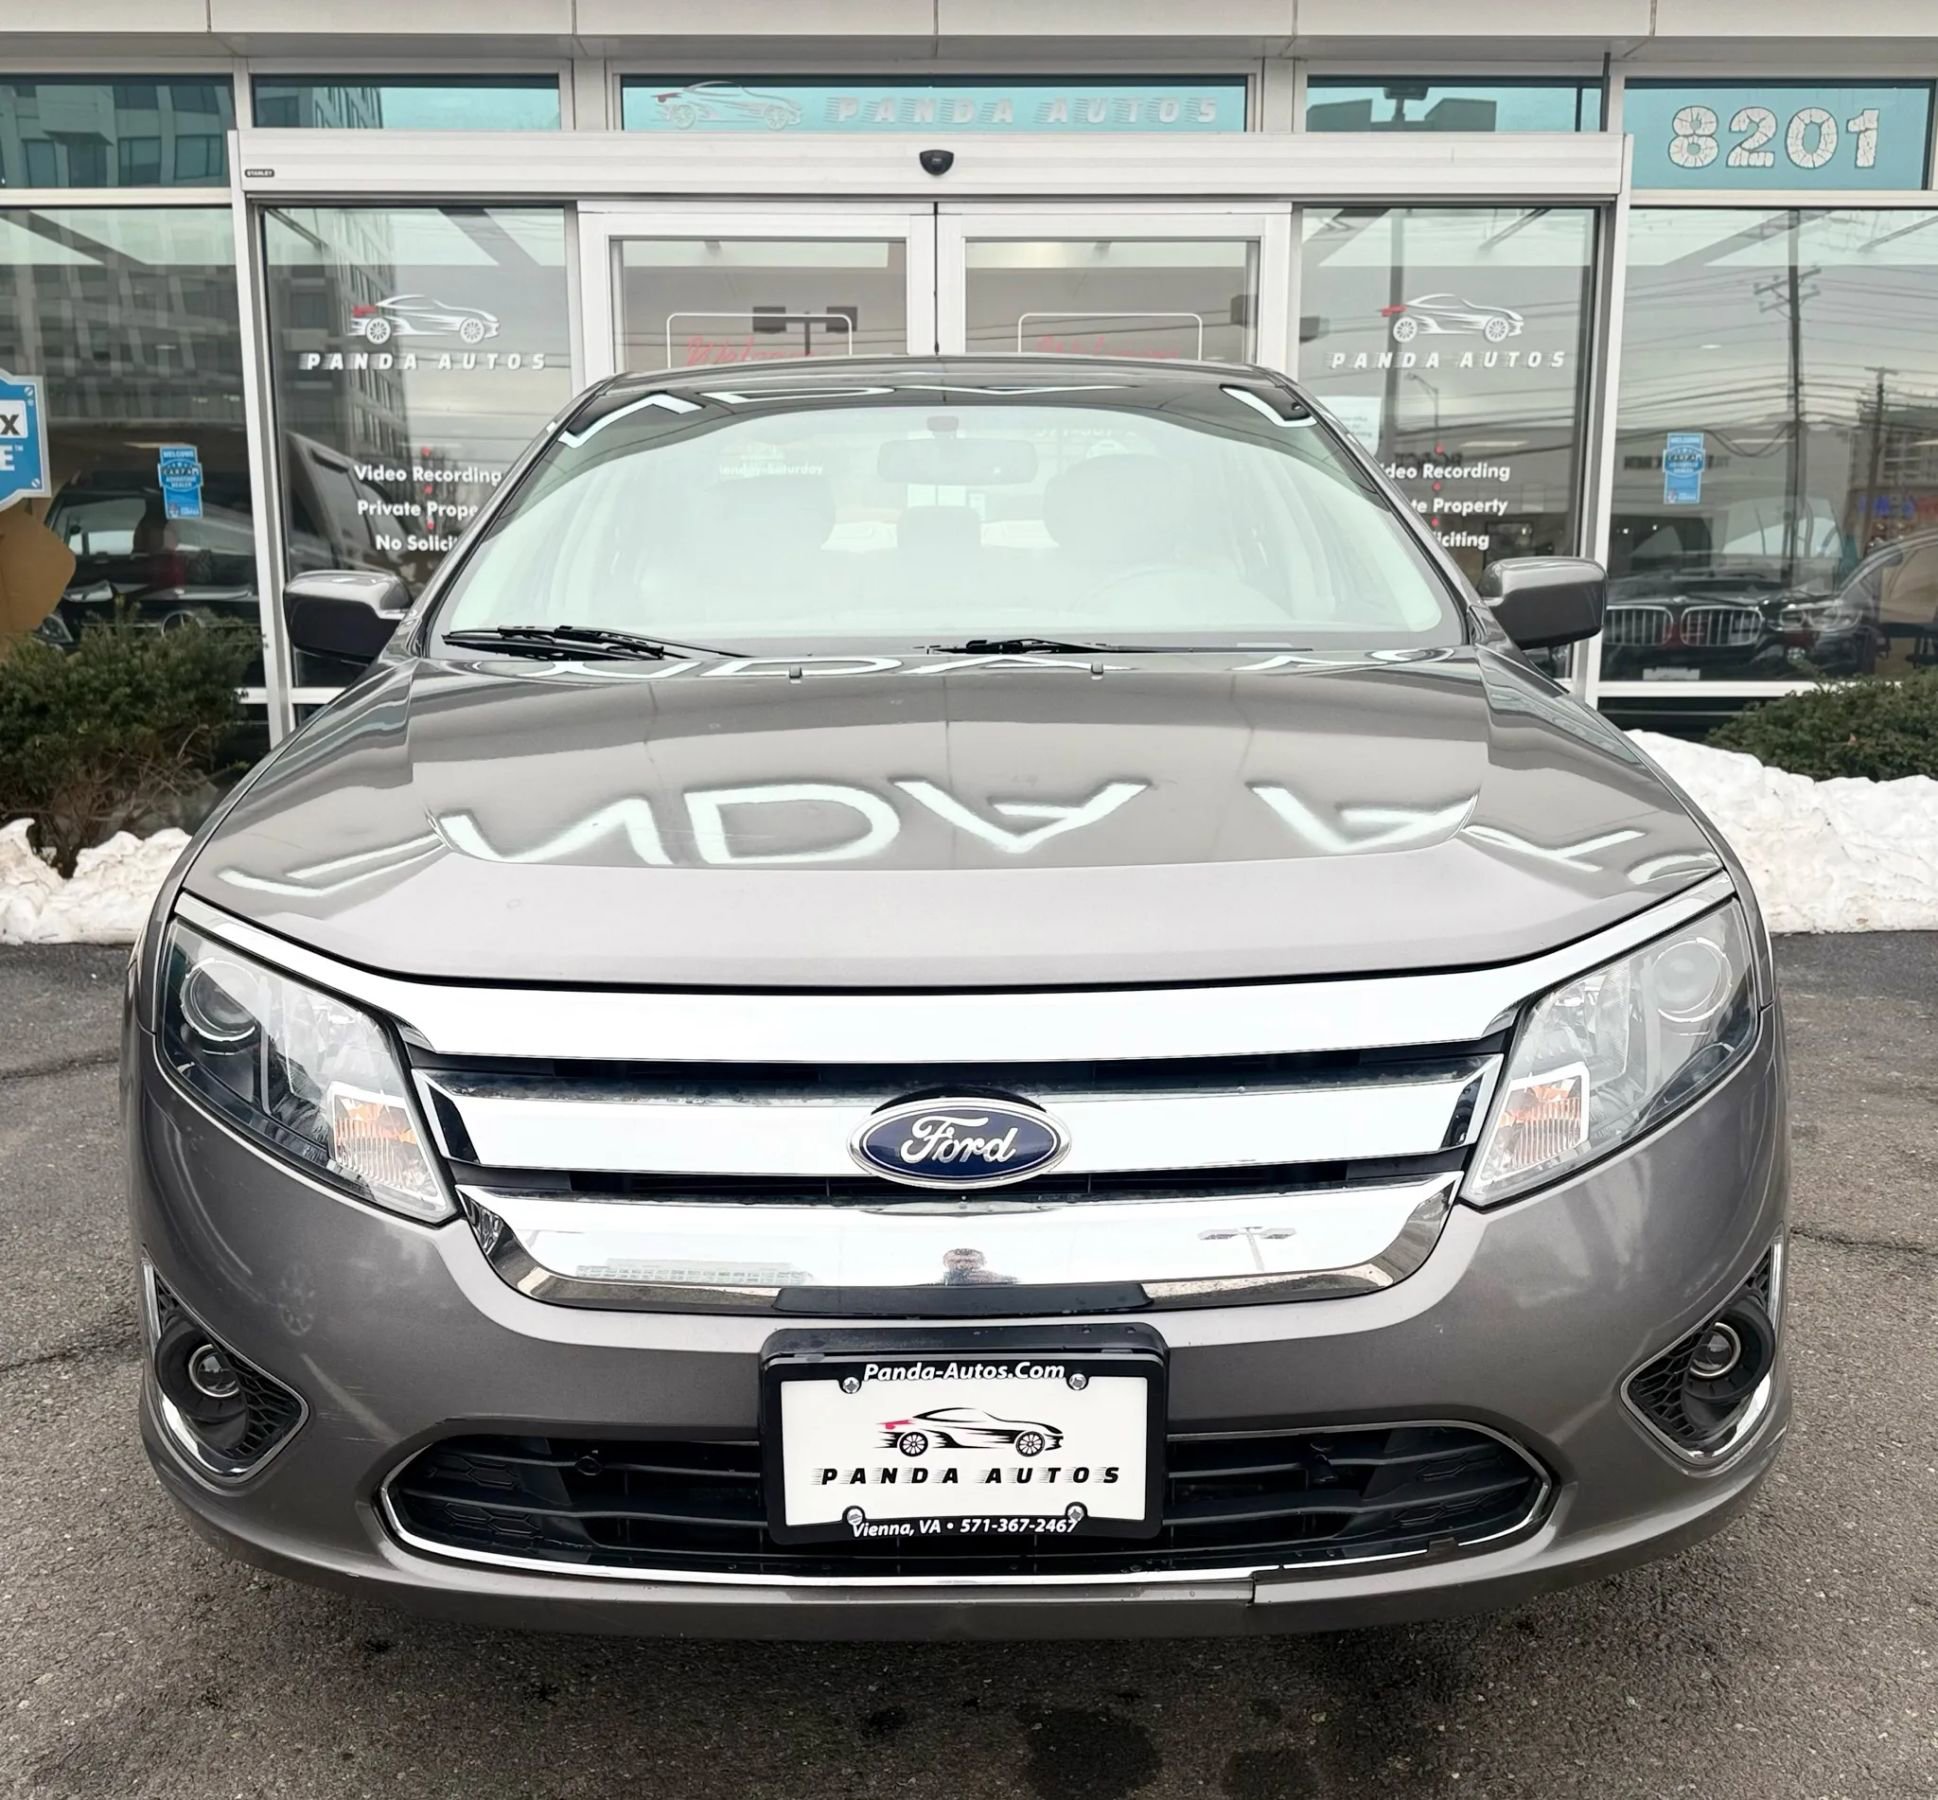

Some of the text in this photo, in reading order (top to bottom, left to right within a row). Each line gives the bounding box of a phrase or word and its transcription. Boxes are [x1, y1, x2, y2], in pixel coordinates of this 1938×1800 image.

[836, 96, 1217, 124] PANDA AUTOS
[1667, 105, 1880, 170] 8201
[307, 353, 545, 370] PANDA AUTOS
[1331, 352, 1565, 368] PANDA AUTOS
[354, 465, 502, 486] Video Recording
[1381, 462, 1510, 481] deo Recording
[357, 500, 478, 521] Private Prope
[1433, 498, 1508, 516] Property
[375, 535, 457, 552] No Solici
[901, 1115, 1020, 1164] Ford
[863, 1362, 1066, 1382] Panda-Autos.Com
[821, 1466, 1120, 1486] PANDA AUTOS
[852, 1517, 1078, 1538] Vienna, VA 571-367-2467
